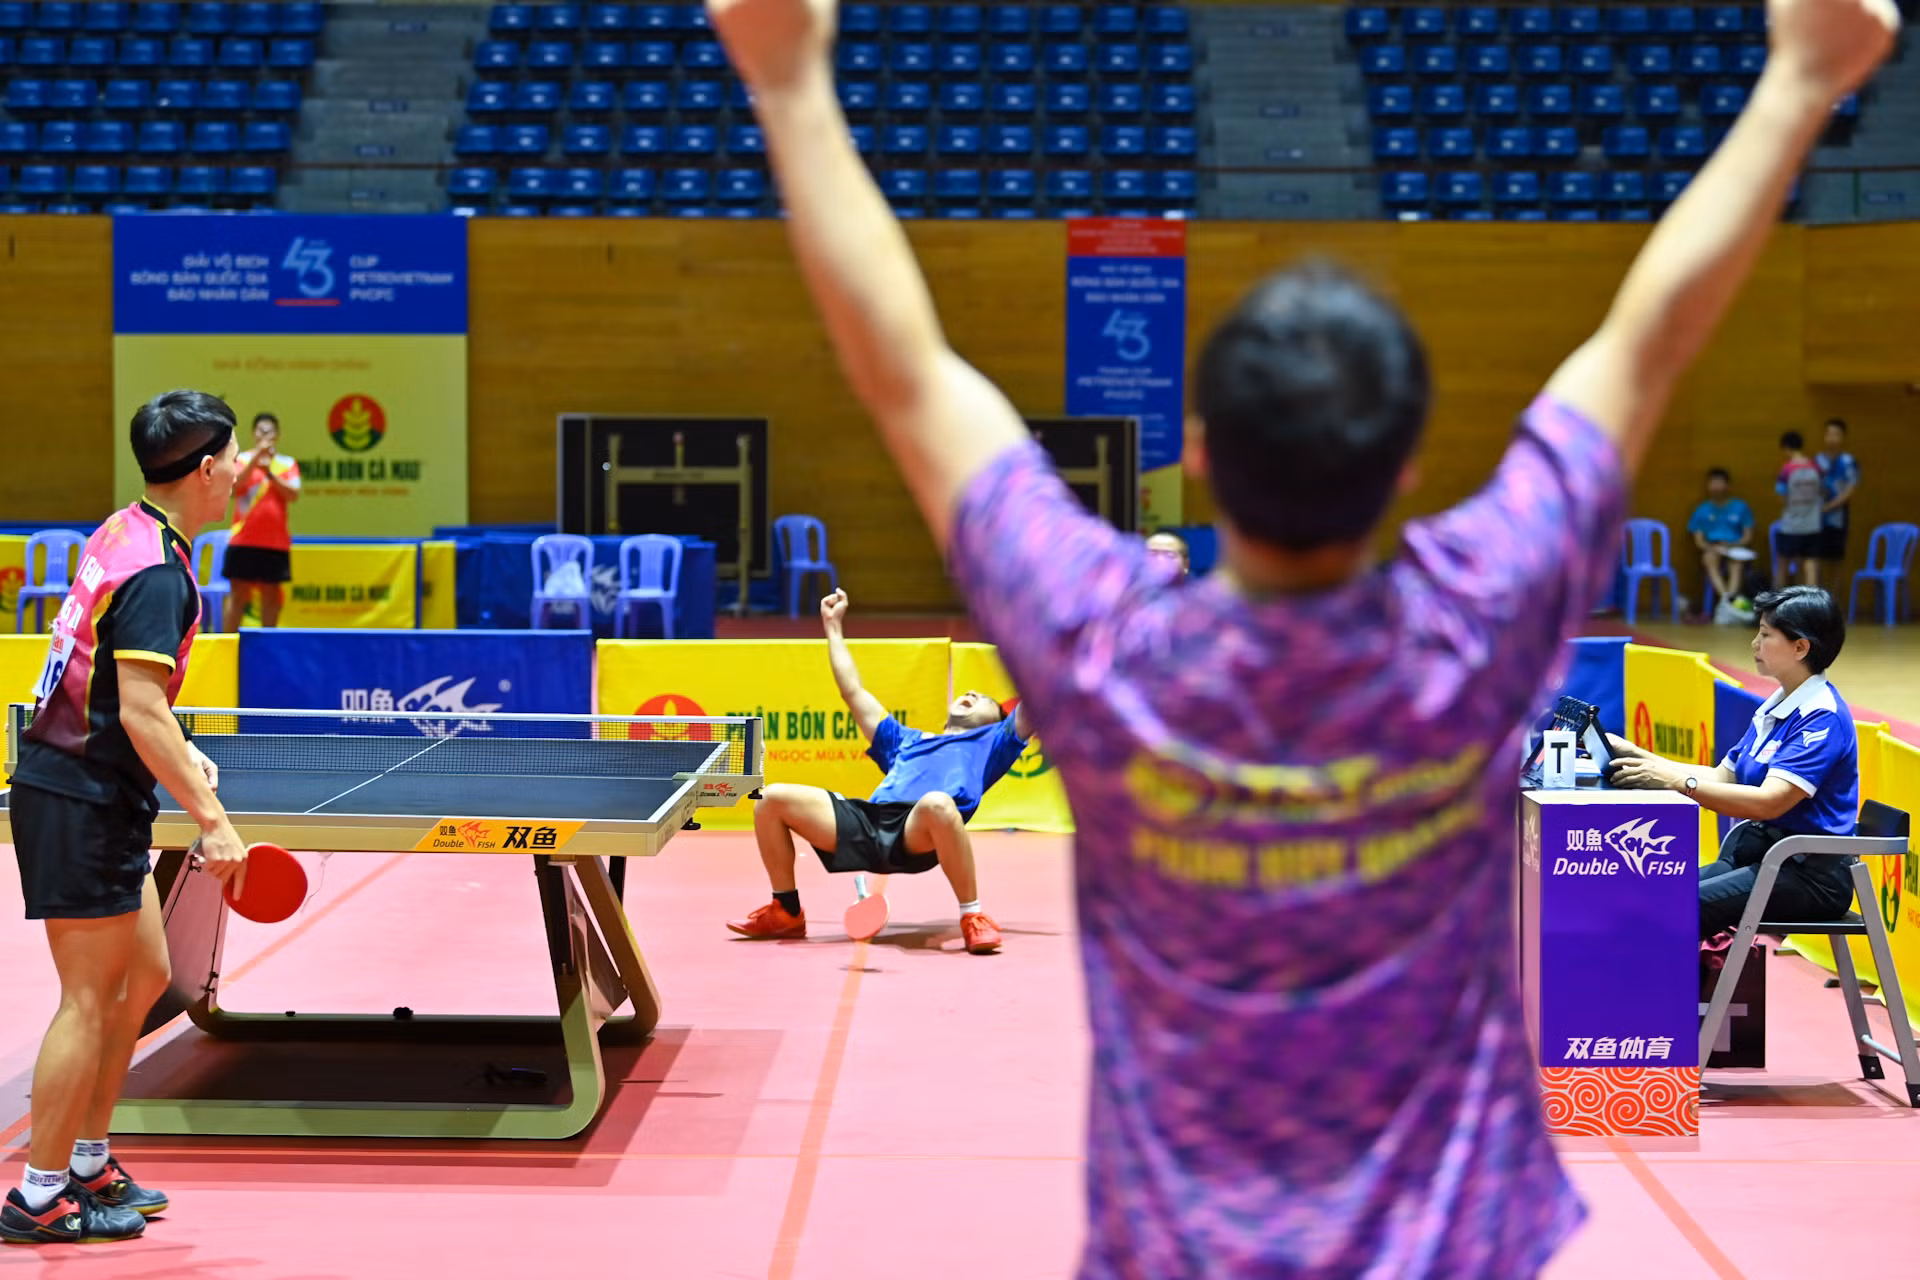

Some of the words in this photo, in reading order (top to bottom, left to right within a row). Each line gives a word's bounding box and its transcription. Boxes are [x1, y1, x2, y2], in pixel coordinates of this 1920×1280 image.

[282, 237, 334, 297] 43
[726, 705, 779, 740] PN
[787, 705, 825, 740] BÓN
[1551, 742, 1569, 774] T
[433, 838, 464, 848] Double
[477, 841, 496, 849] FISH
[502, 825, 557, 849] 双鱼
[1566, 828, 1603, 852] 双魚
[1553, 857, 1619, 876] Double
[1647, 860, 1686, 876] FISH
[1563, 1036, 1674, 1060] 双鱼体育
